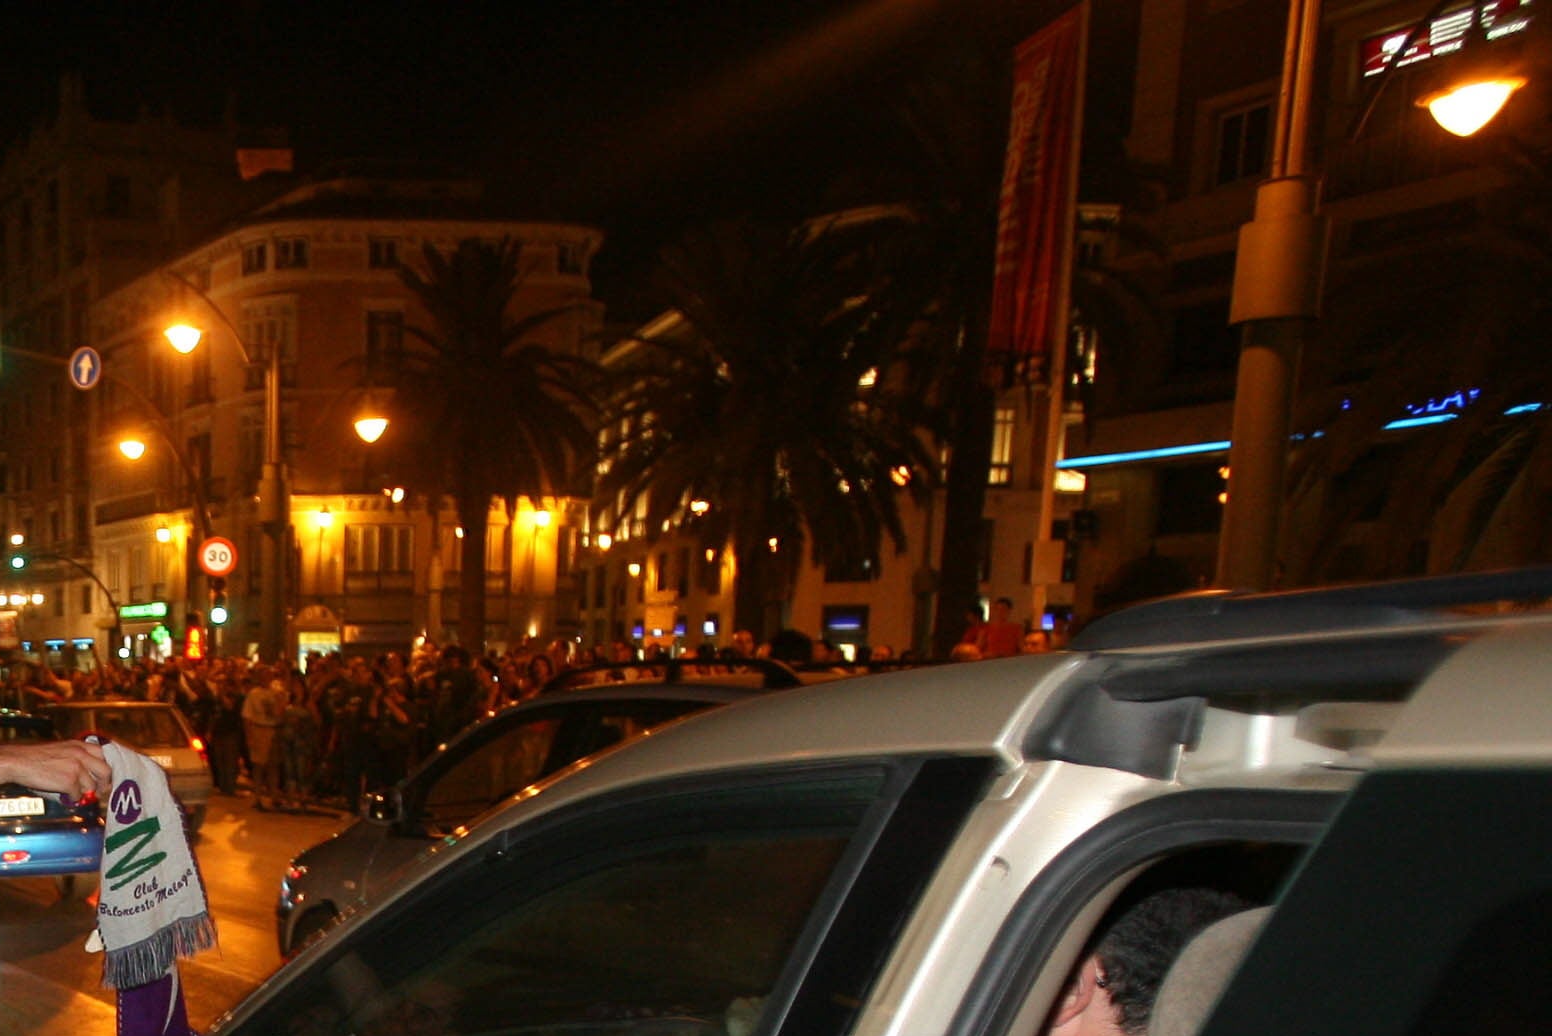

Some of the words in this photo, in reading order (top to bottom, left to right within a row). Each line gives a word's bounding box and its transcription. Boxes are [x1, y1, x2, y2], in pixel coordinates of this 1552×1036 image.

[208, 549, 228, 563] 30
[134, 876, 158, 899] Club
[99, 899, 155, 917] Baloncesto
